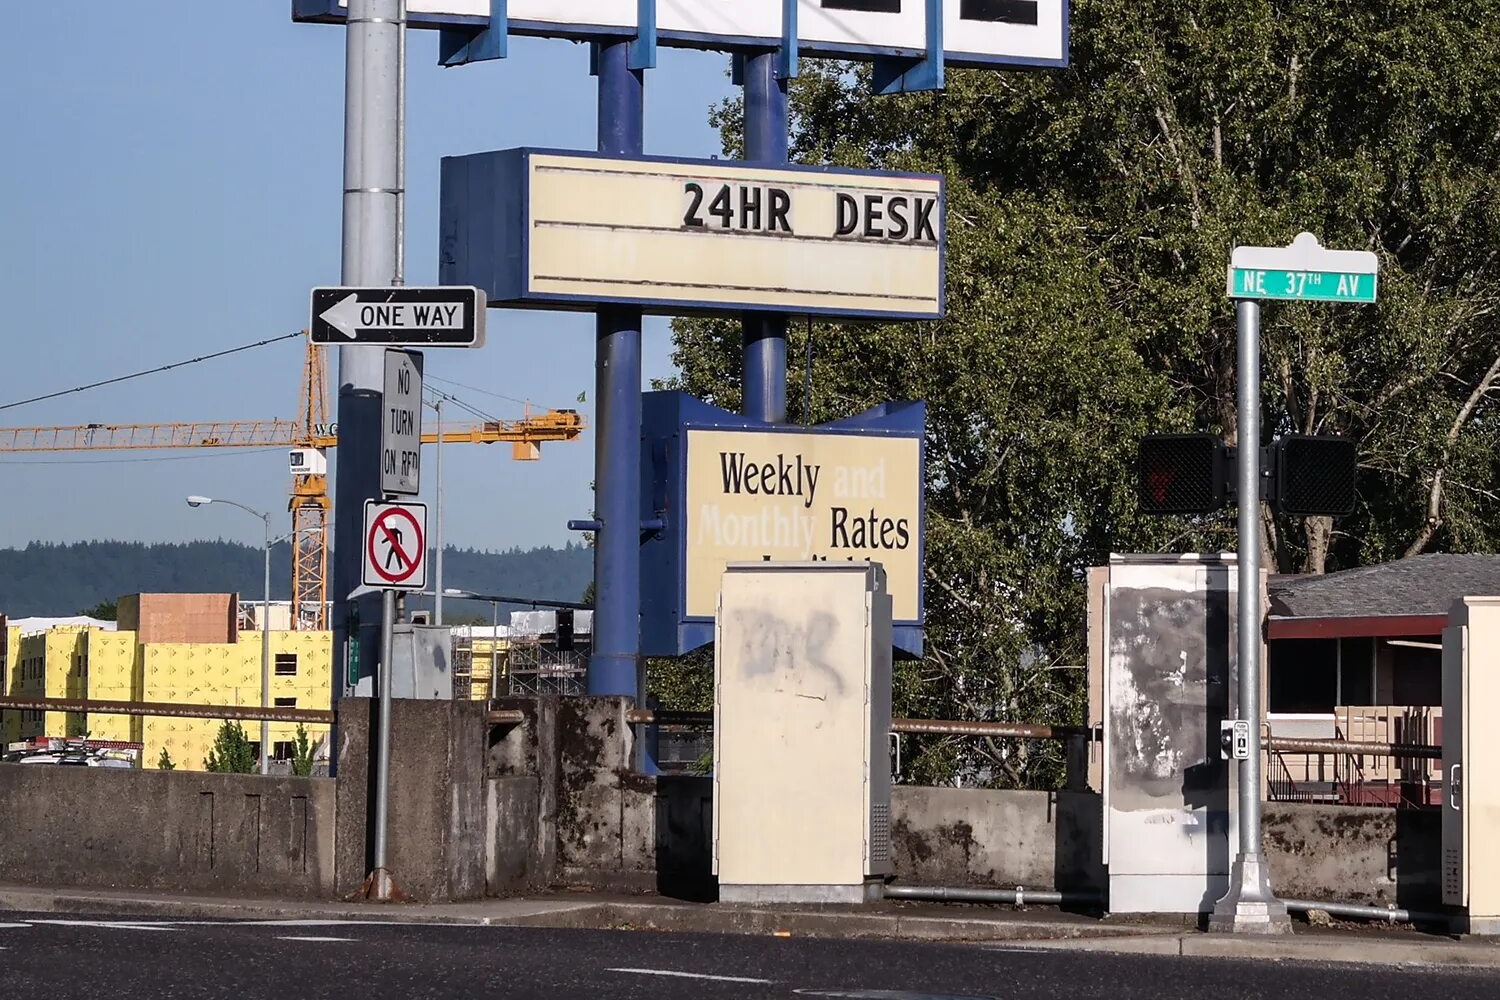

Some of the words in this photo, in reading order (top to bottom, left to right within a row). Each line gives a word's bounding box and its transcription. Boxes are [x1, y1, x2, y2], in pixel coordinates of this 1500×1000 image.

[685, 183, 793, 233] 24HR
[836, 192, 937, 242] DESK
[1244, 271, 1266, 294] NE
[1286, 272, 1321, 296] 37TH
[1336, 275, 1359, 297] AV
[361, 306, 404, 327] ONE
[413, 306, 457, 327] WAY
[397, 369, 410, 396] NO
[391, 408, 414, 436] TURN
[384, 449, 396, 475] ON
[720, 452, 820, 508] Weekly
[834, 459, 886, 498] and
[697, 503, 816, 557] Monthly
[830, 507, 909, 550] Rates
